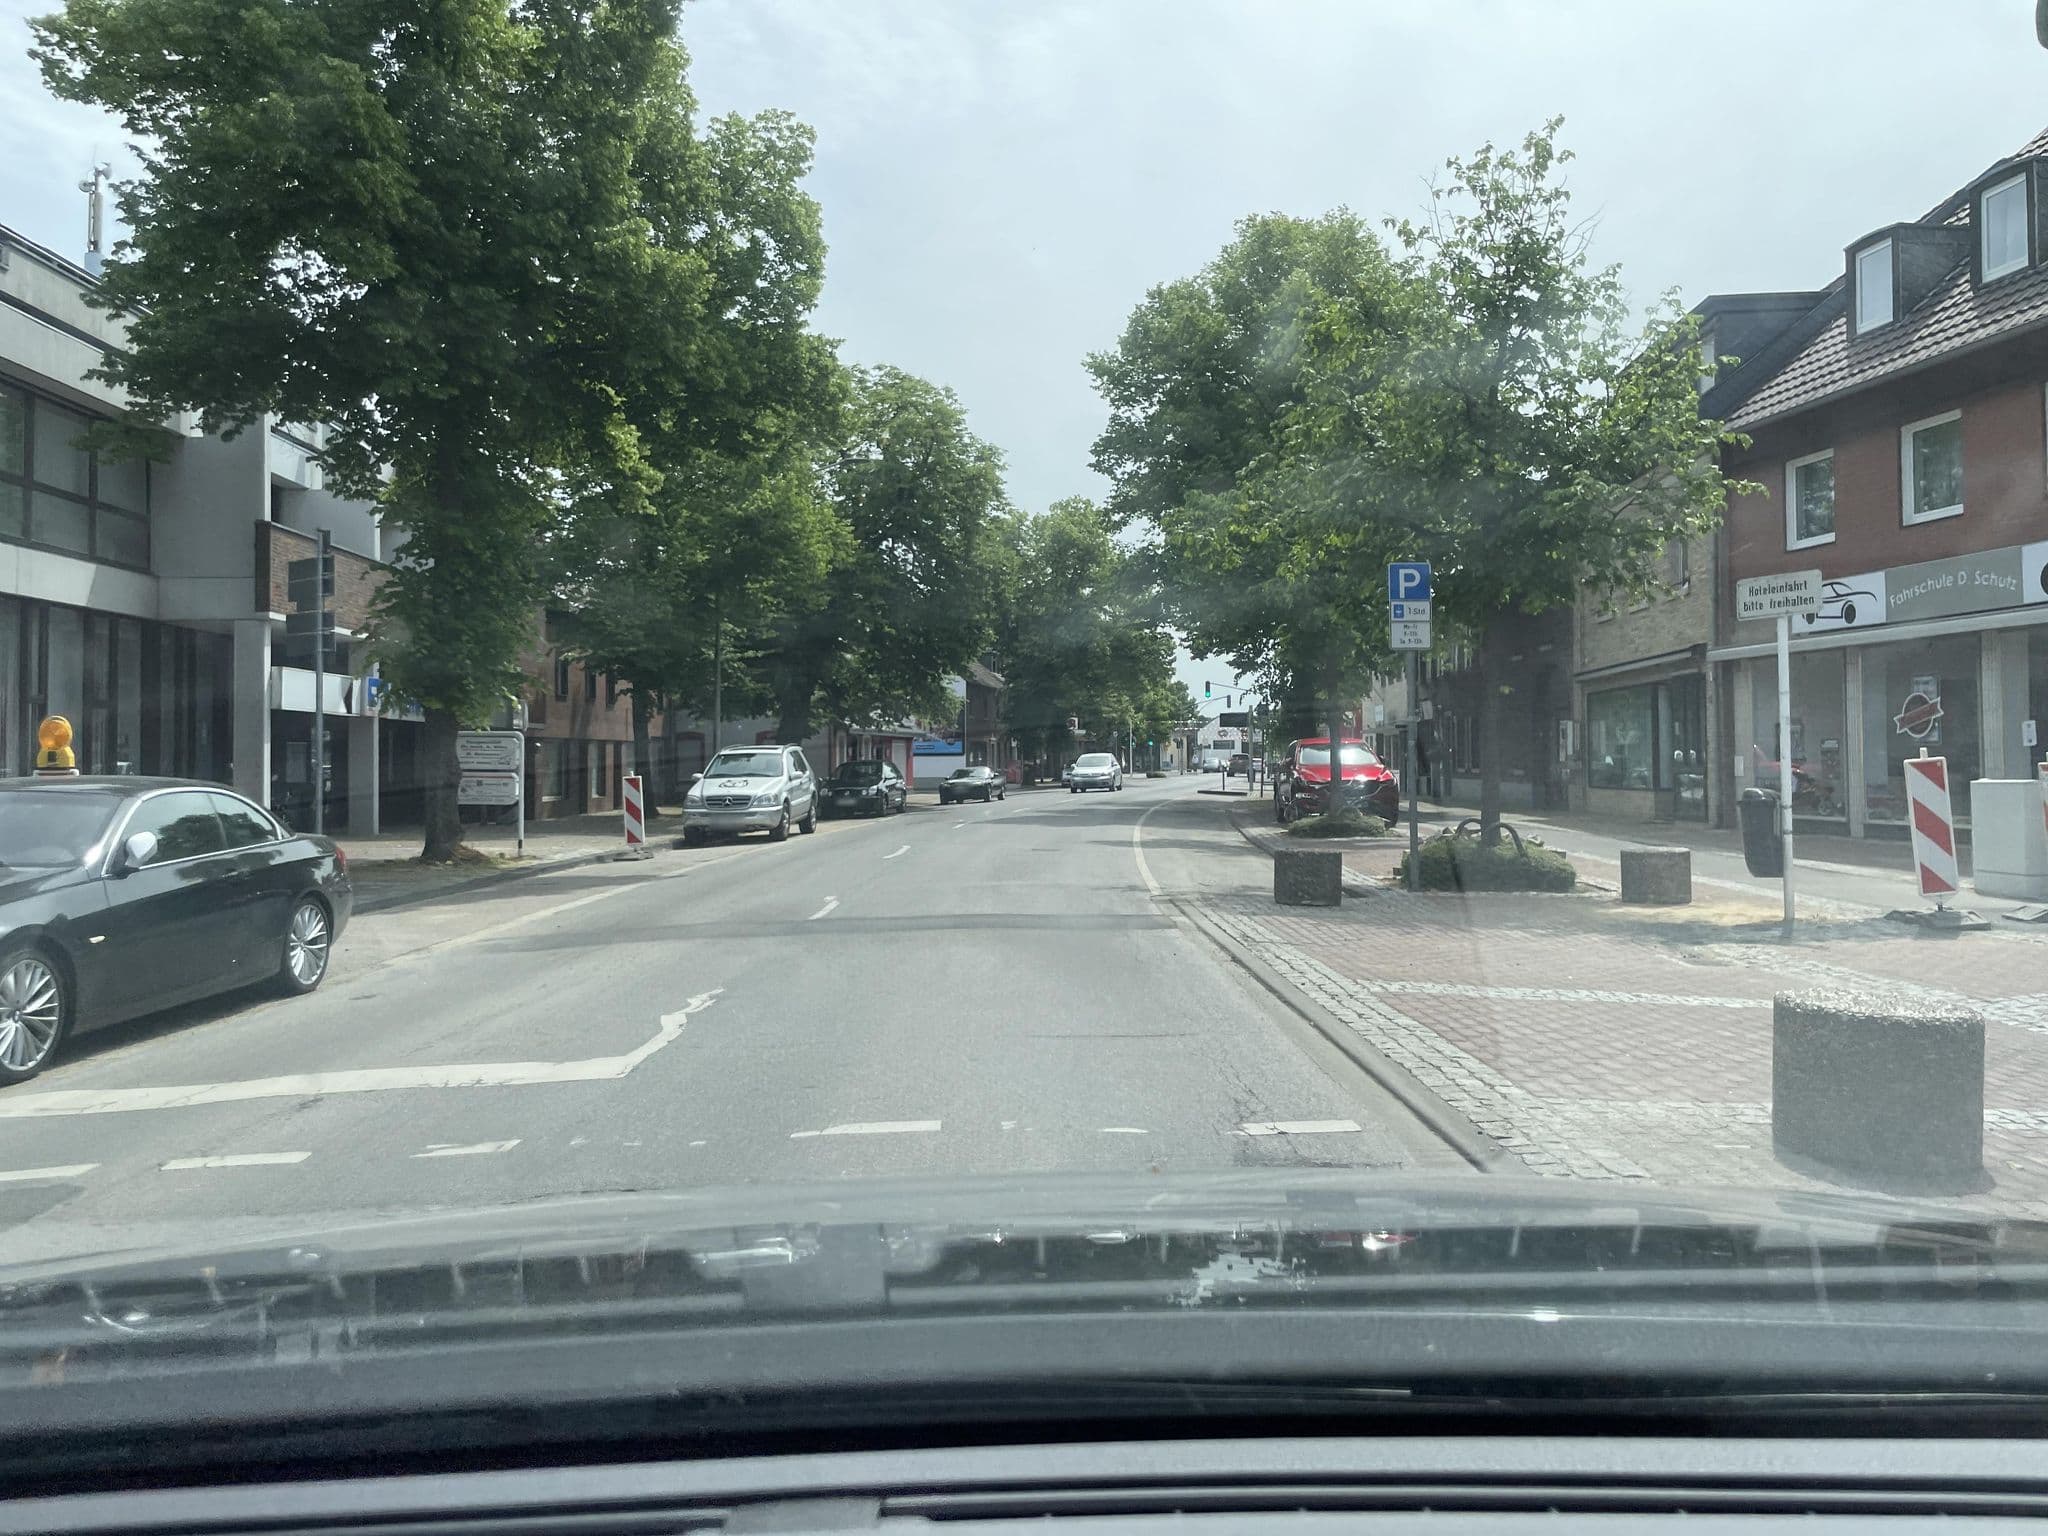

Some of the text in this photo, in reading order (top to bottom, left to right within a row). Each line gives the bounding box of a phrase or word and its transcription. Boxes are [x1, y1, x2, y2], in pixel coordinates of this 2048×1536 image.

[1399, 568, 1421, 599] P
[1748, 580, 1808, 597] Hoteleinfahrt
[1889, 573, 1954, 609] Fahrschule
[1743, 596, 1815, 612] bitte freihalten
